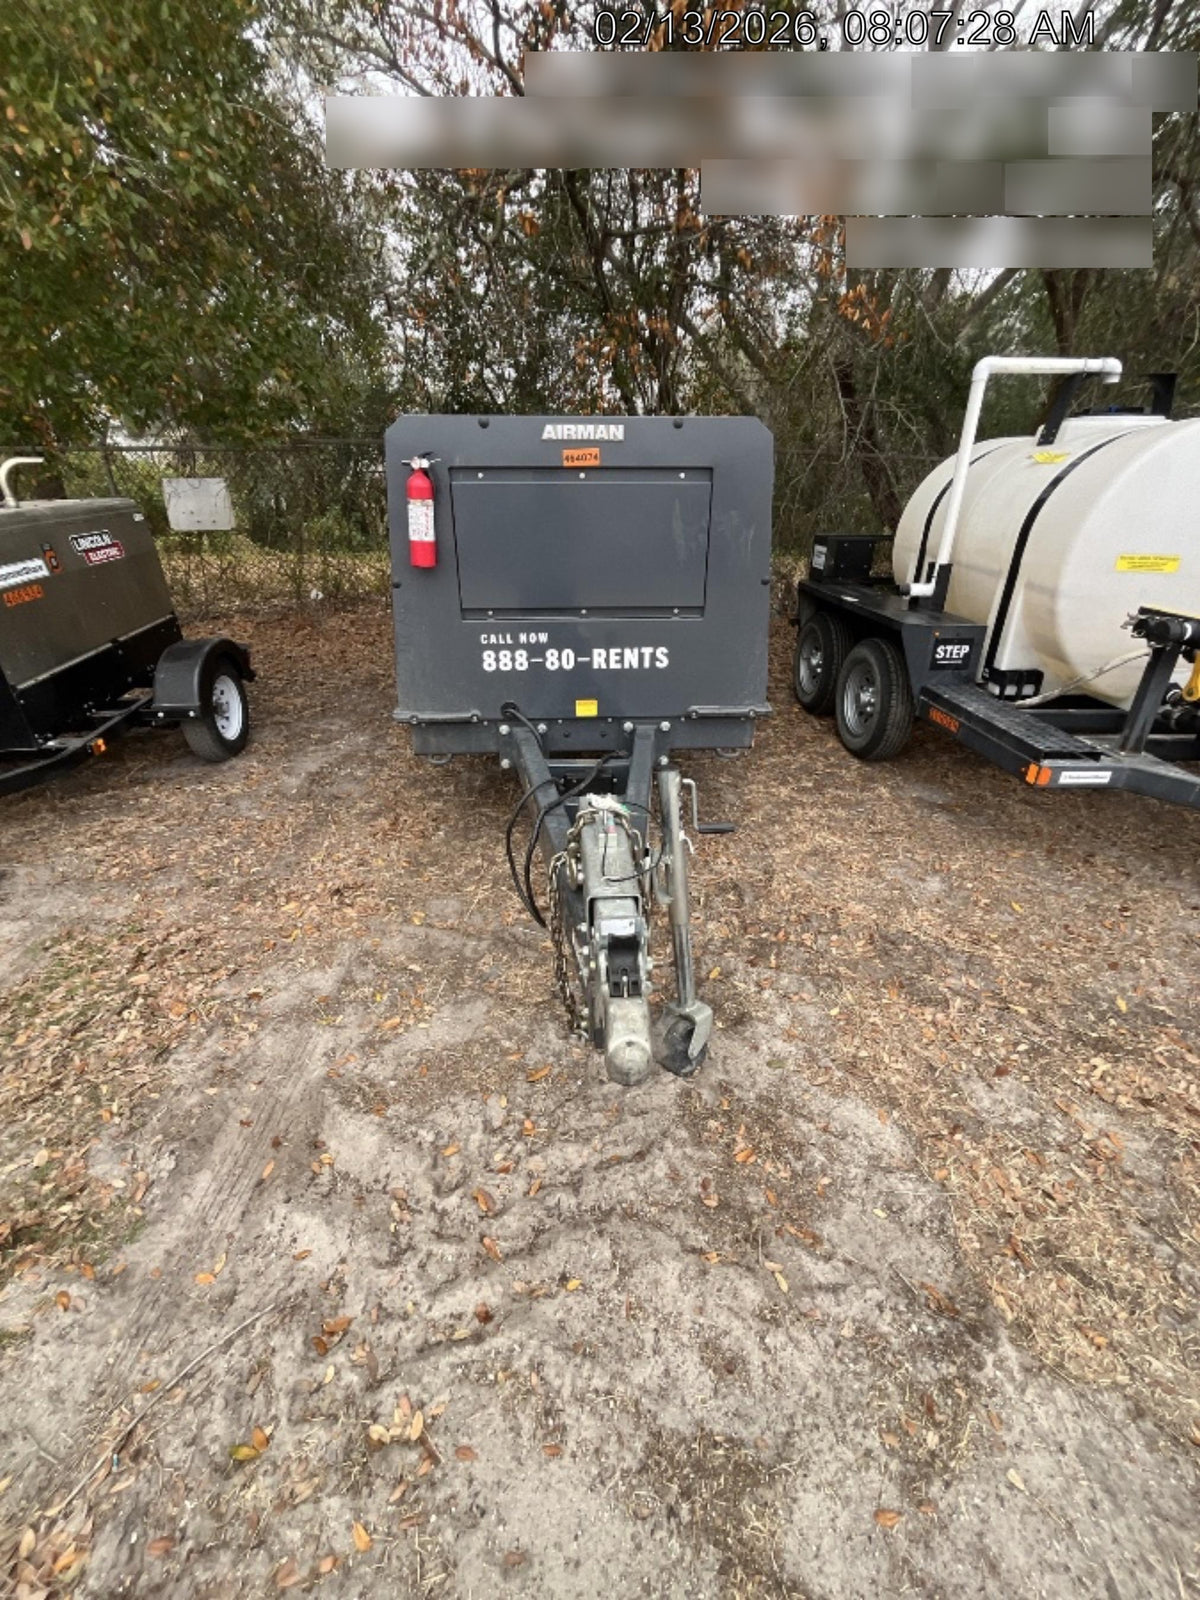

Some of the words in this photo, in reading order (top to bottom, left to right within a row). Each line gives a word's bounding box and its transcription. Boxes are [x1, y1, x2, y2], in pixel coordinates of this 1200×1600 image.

[541, 424, 625, 441] AIRMAN
[480, 633, 514, 645] CALL
[519, 632, 549, 644] NOW
[482, 647, 670, 672] 888-80-RENTS
[935, 644, 970, 659] STEP
